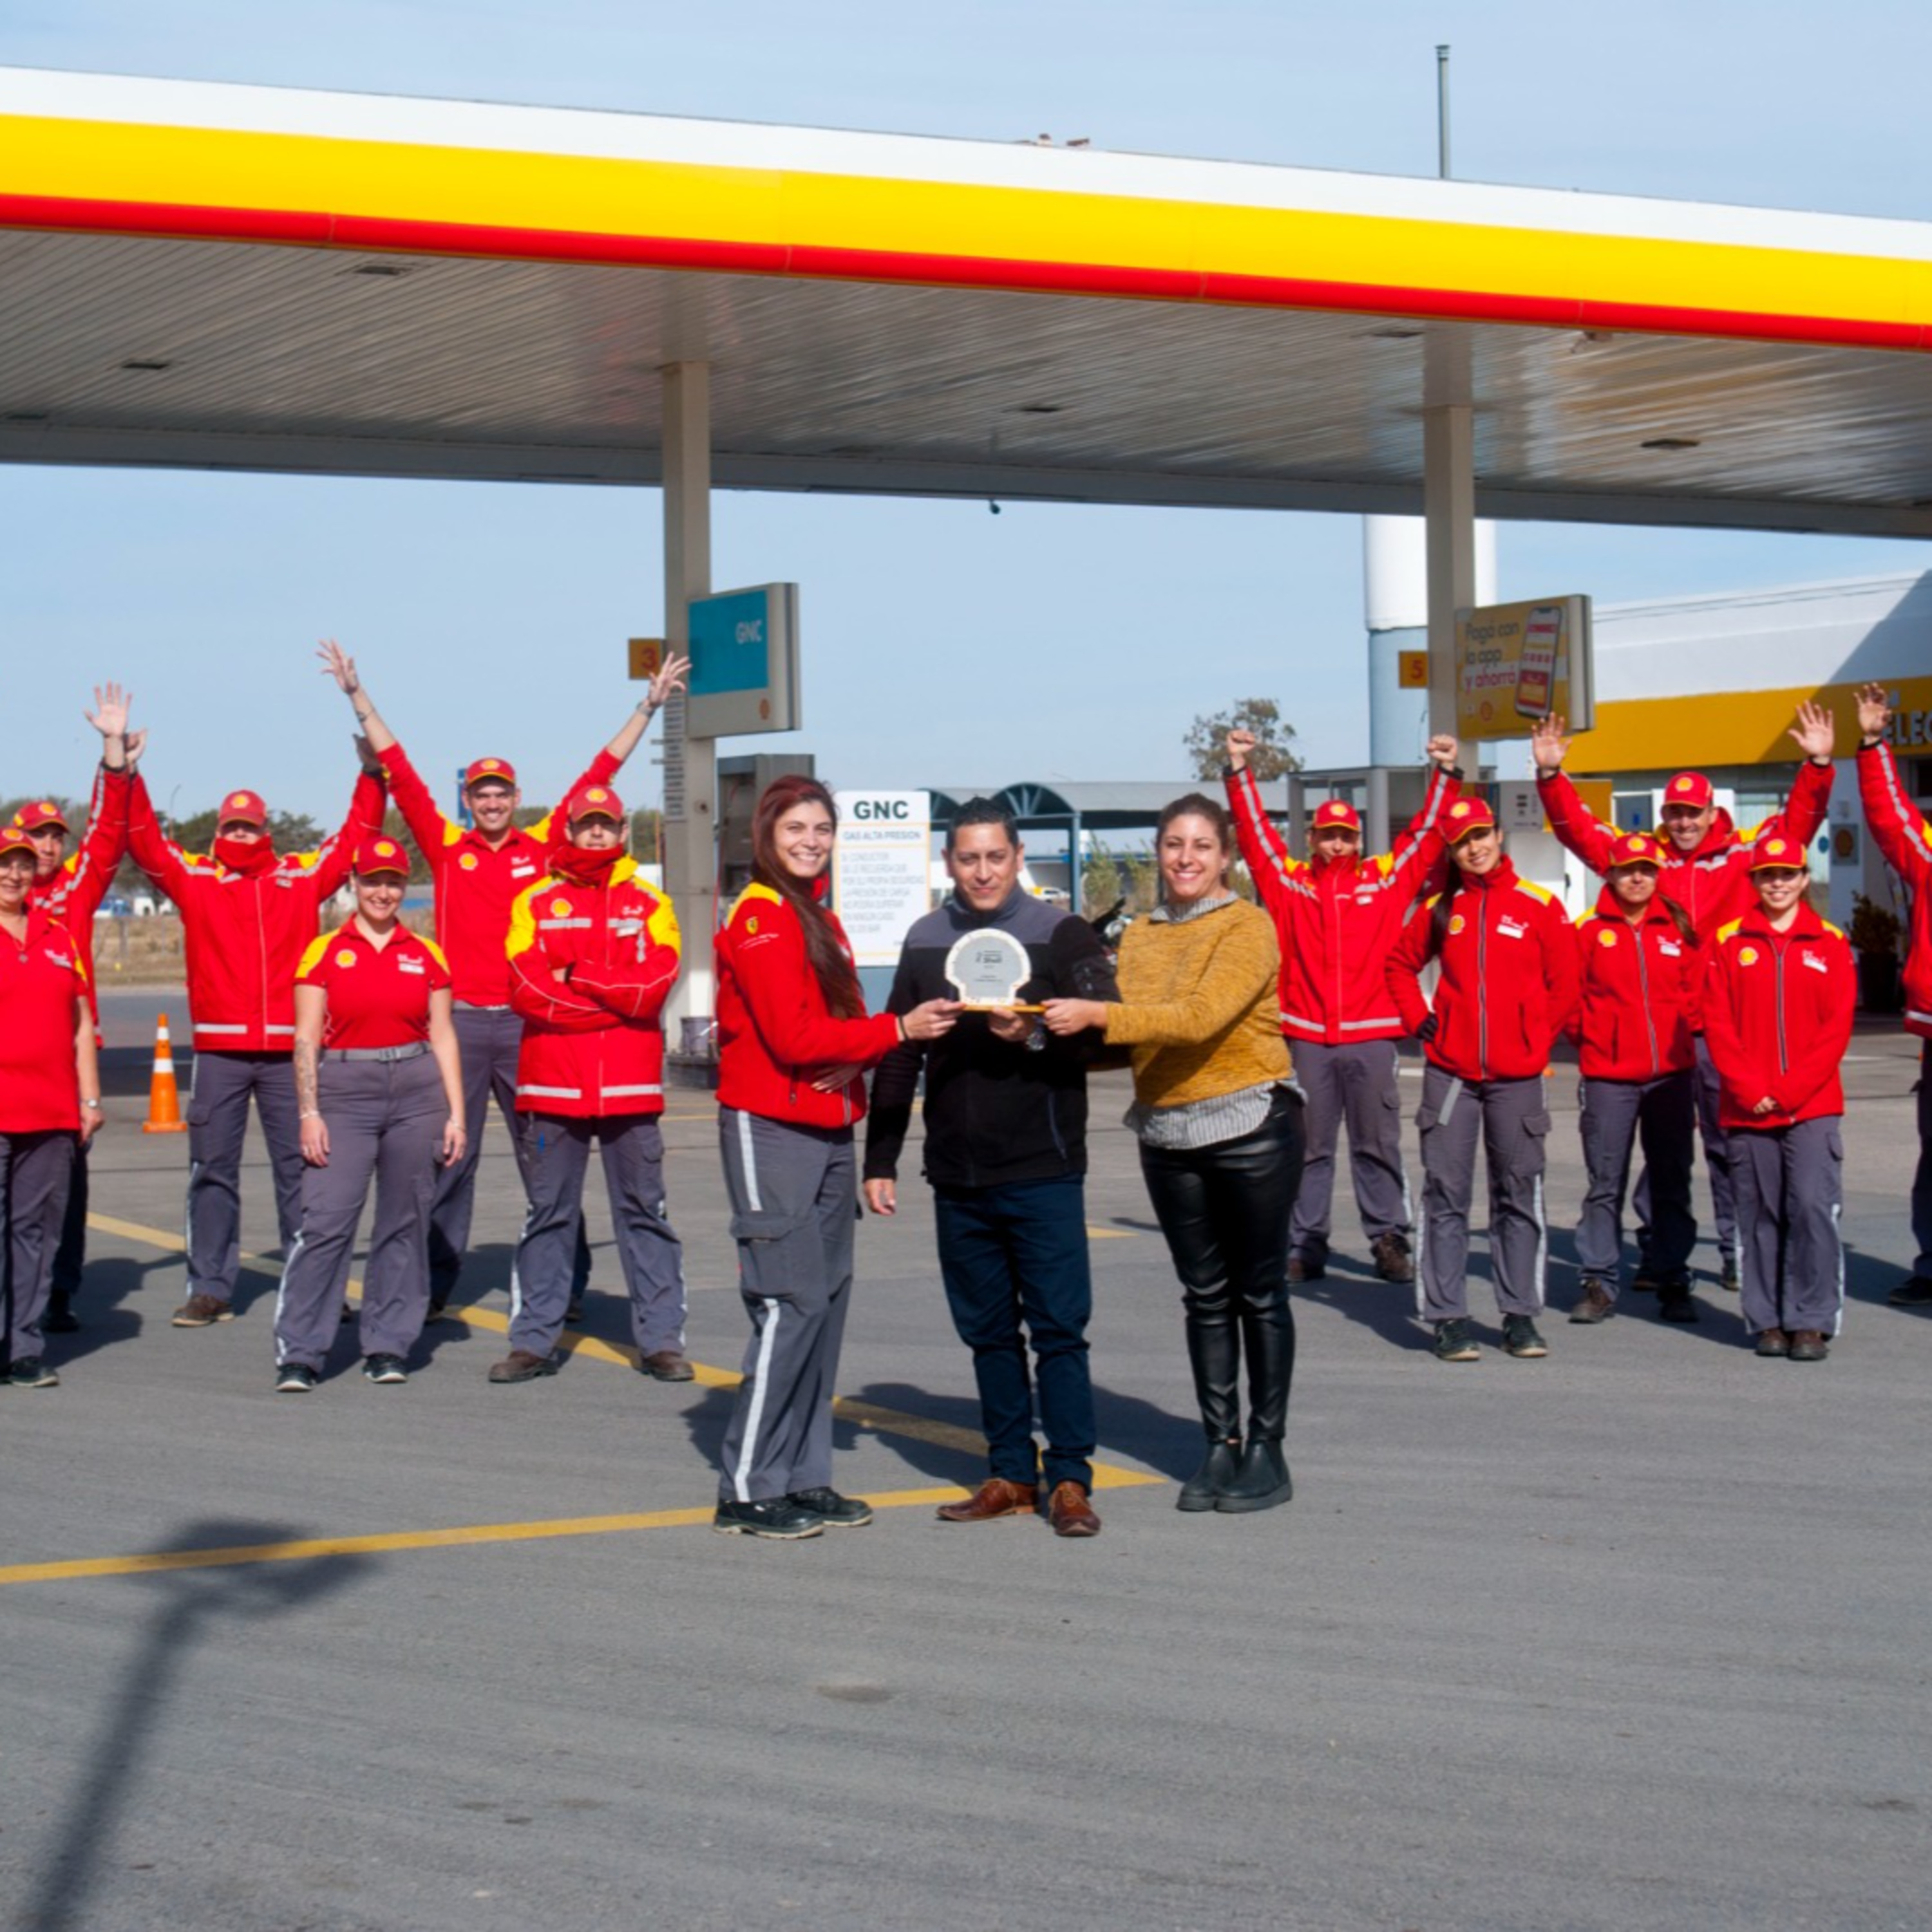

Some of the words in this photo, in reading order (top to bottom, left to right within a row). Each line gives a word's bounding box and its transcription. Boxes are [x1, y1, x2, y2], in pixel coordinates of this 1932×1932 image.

[735, 620, 762, 645] GNC
[1498, 622, 1519, 638] con
[641, 647, 656, 669] 3
[1479, 649, 1502, 668] app
[1410, 659, 1423, 680] 5
[1465, 676, 1473, 694] y
[853, 800, 909, 820] GNC
